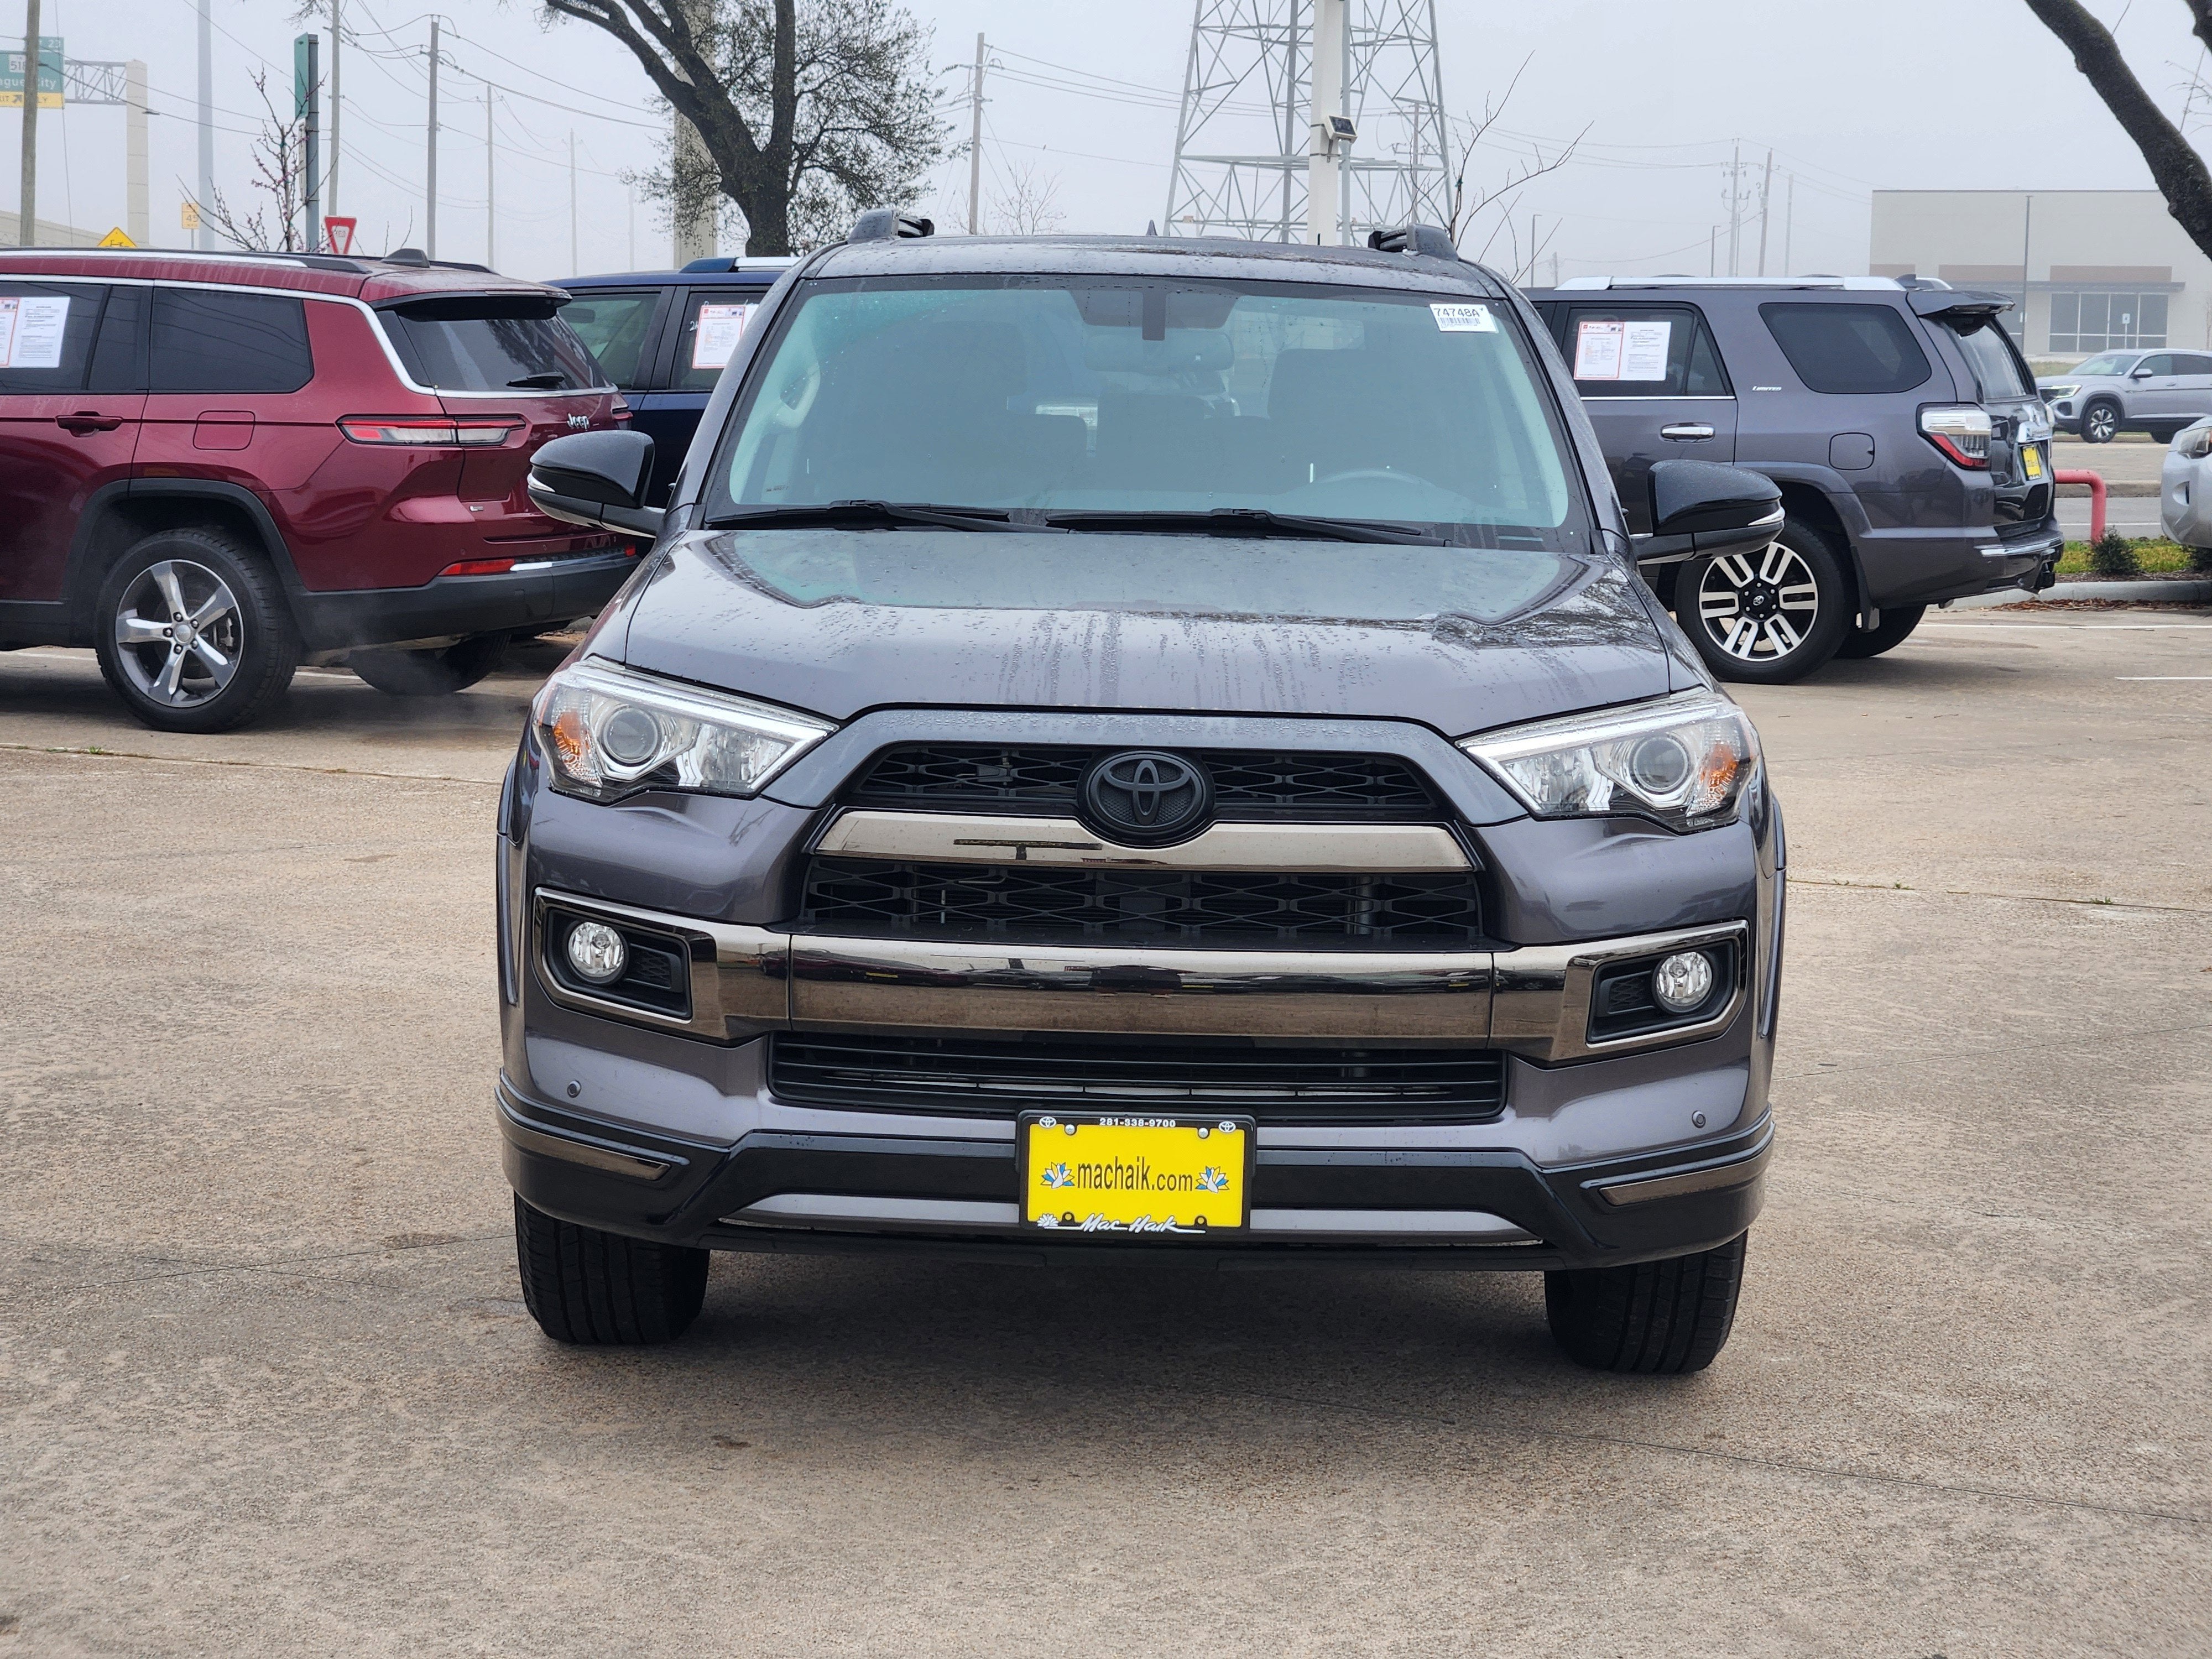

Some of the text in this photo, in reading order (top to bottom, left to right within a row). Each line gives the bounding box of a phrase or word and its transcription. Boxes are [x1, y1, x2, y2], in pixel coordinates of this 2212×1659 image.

[1433, 308, 1480, 317] 74748A
[567, 413, 589, 430] Jeep
[1099, 1118, 1176, 1128] 281-338-9700
[1078, 1155, 1193, 1191] machaik.com
[1079, 1213, 1177, 1233] Mac Haik
